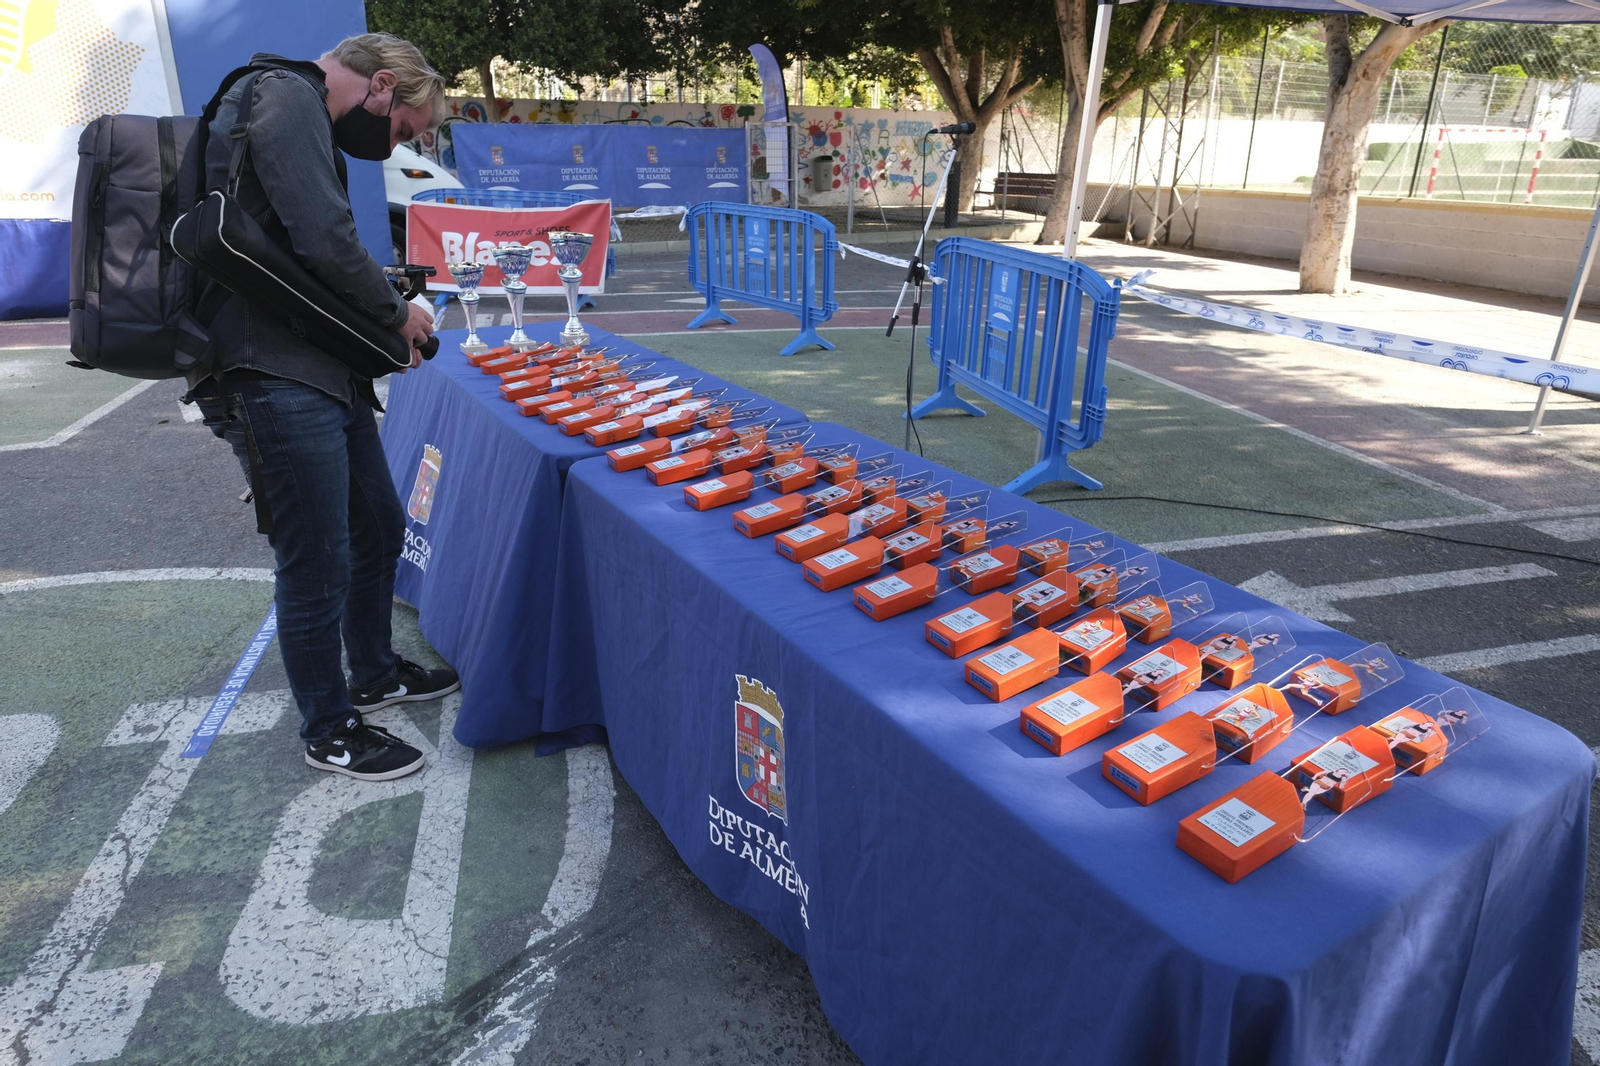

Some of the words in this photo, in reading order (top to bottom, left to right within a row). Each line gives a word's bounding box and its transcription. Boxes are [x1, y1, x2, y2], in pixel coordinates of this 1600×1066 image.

[536, 226, 570, 236] SHOES
[442, 231, 562, 267] Blae
[232, 641, 268, 678] DISTANCIA
[225, 678, 247, 689] DE
[196, 691, 238, 736] SEGURIDAD
[709, 820, 736, 854] DE
